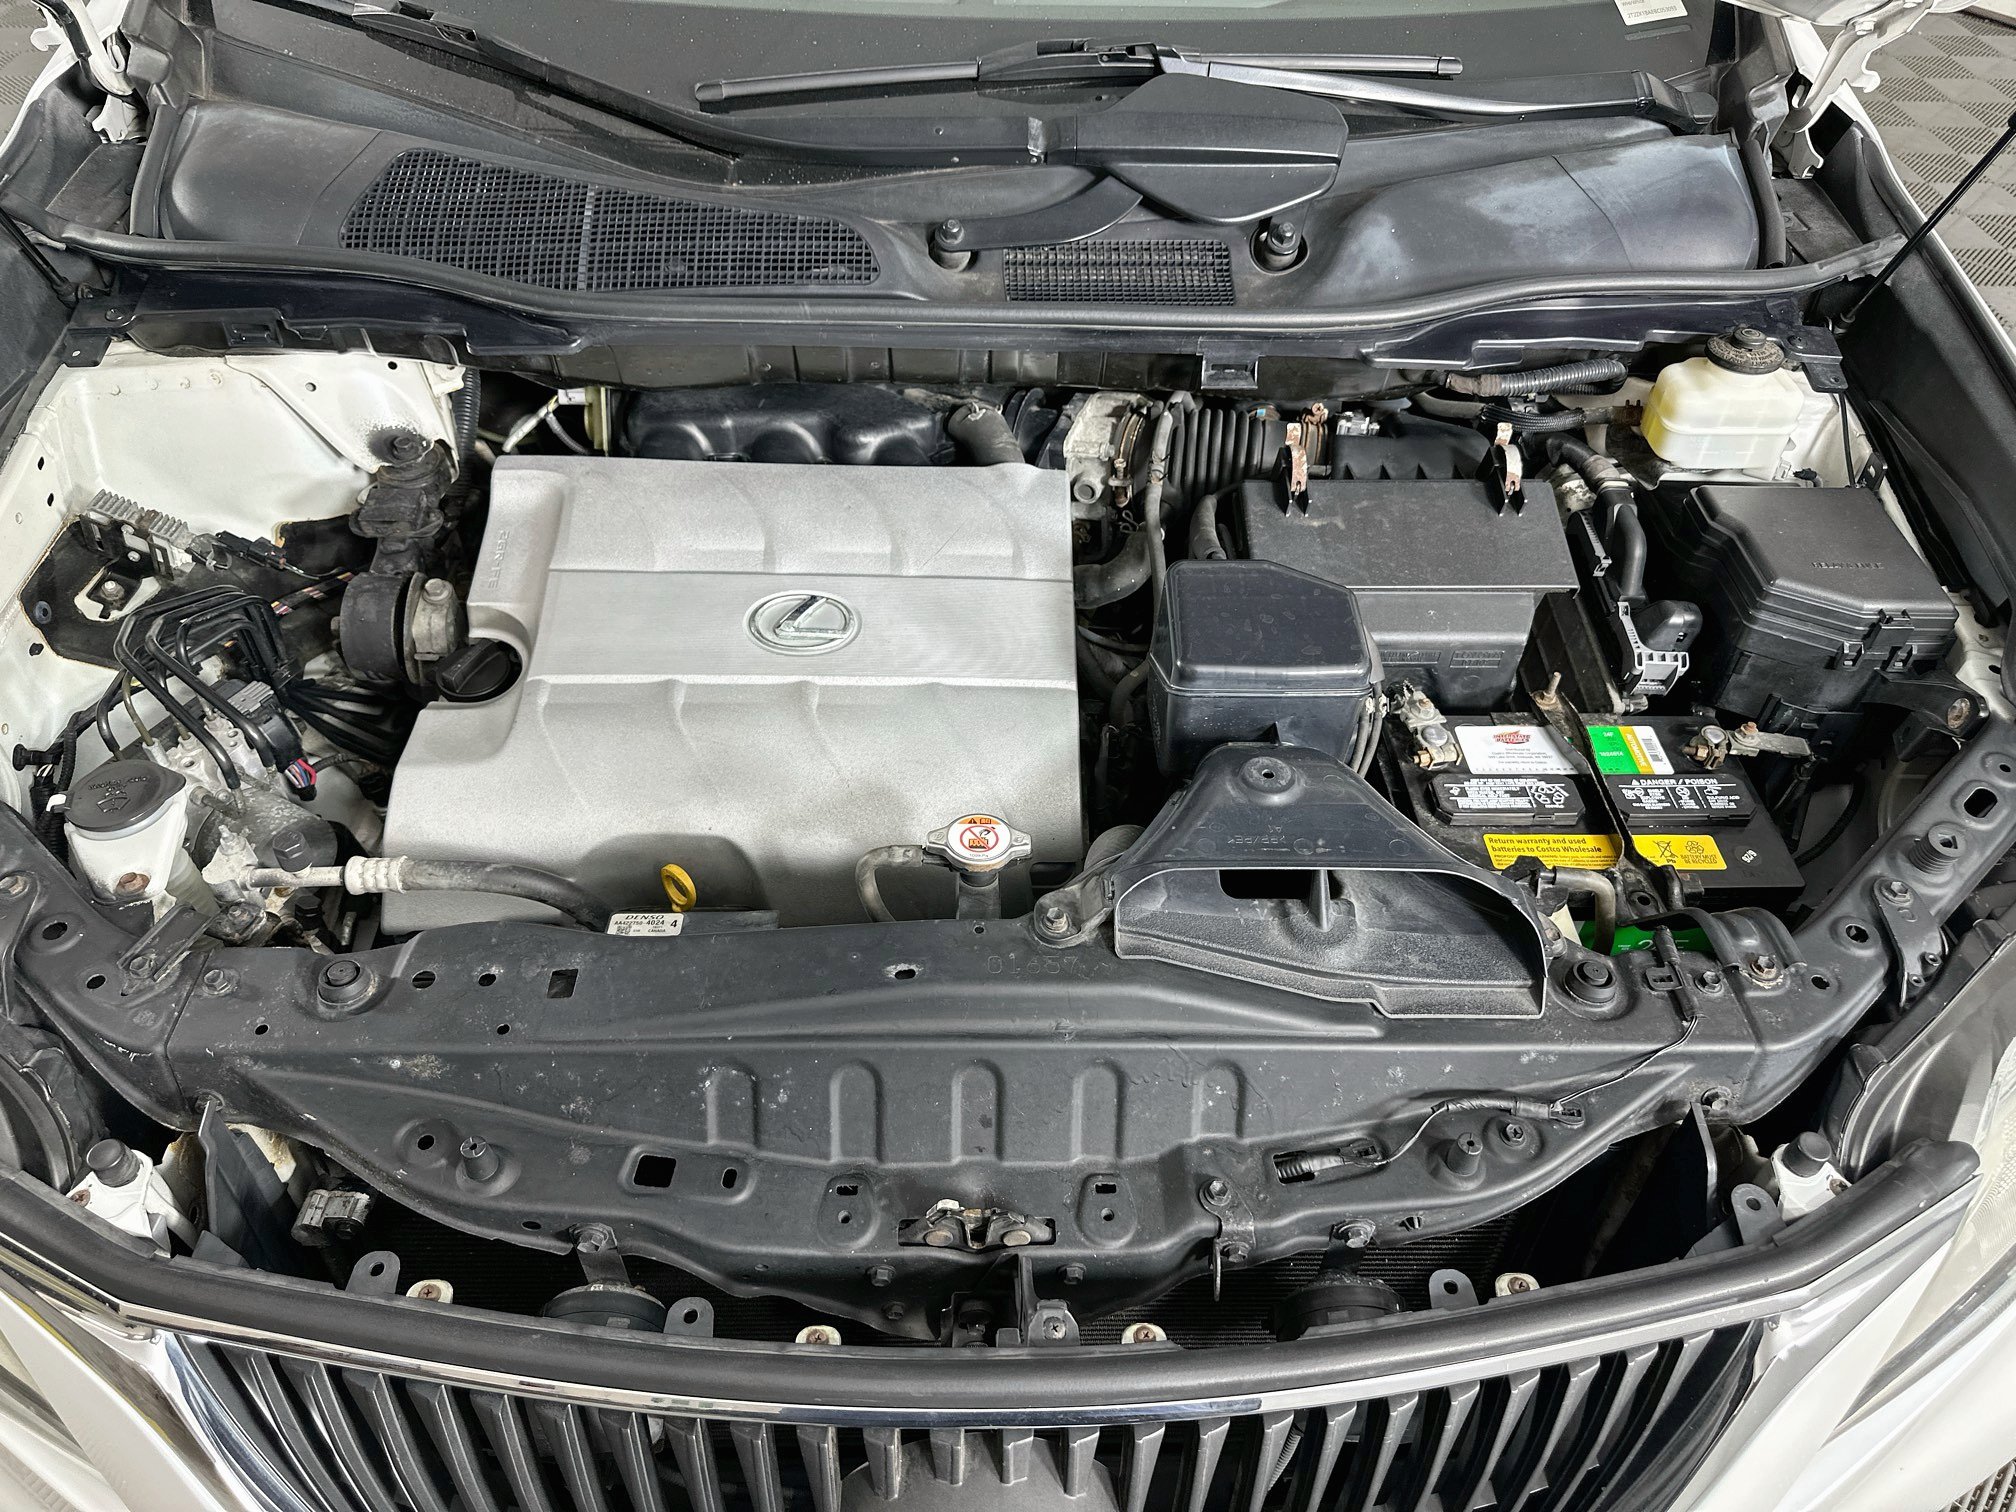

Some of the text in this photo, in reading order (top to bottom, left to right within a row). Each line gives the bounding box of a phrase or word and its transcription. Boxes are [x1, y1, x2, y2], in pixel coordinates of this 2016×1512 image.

[1625, 733, 1648, 767] AUTOMOTIVE
[1516, 837, 1551, 845] warranty
[1561, 845, 1602, 853] Wholesale
[670, 919, 678, 928] 4
